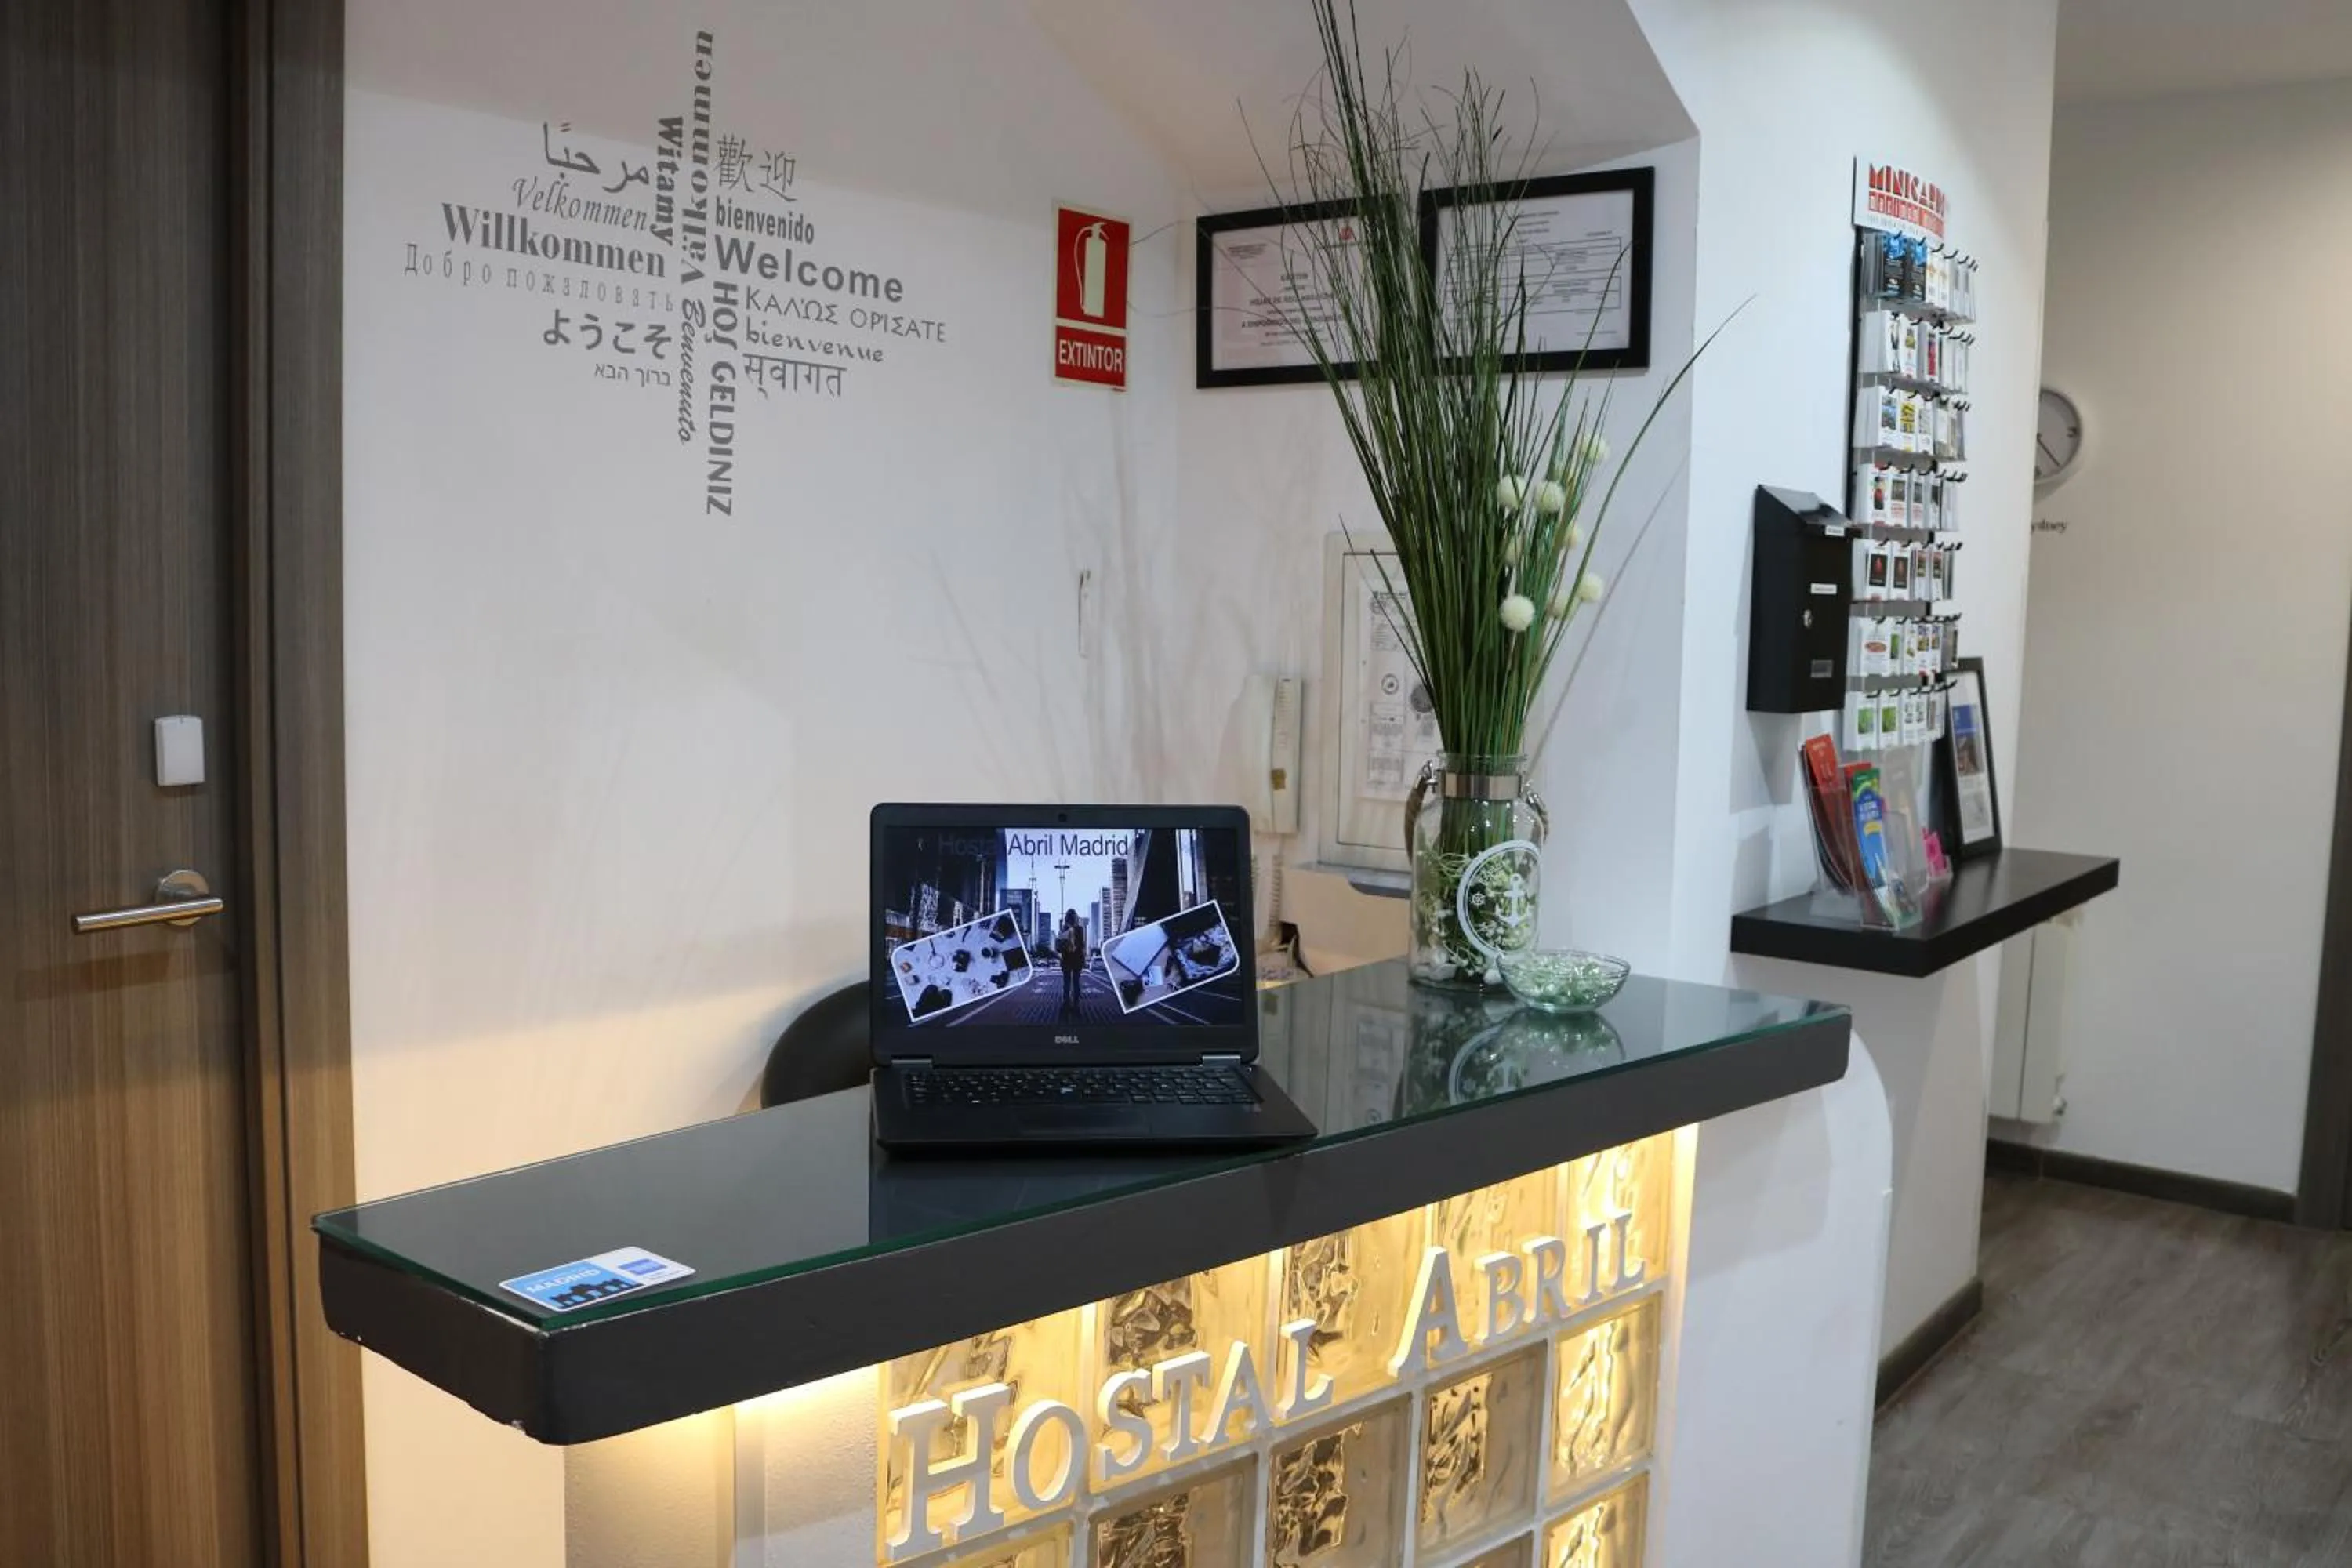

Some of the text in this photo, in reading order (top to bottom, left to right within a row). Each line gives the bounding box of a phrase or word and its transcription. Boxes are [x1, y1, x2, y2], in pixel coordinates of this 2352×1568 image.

[650, 116, 683, 245] Witamy
[680, 30, 713, 285] Välkommen
[713, 132, 797, 201] 歡迎
[512, 176, 648, 231] Velkommen
[716, 196, 815, 244] bienvenido
[441, 203, 666, 278] Willkommen
[404, 243, 673, 312] Добро пожаловать
[713, 236, 904, 303] Welcome
[543, 309, 672, 360] ようこそ
[746, 317, 884, 362] bienvenue
[1059, 339, 1123, 373] EXTINTOR
[594, 363, 670, 387] ברוך הבא
[677, 298, 705, 442] Benvenuto
[706, 361, 736, 516] GELDINIZ
[2031, 519, 2068, 535] ydney
[938, 833, 1128, 856] Hosta Abril Madrid
[1054, 1035, 1080, 1044] DELL
